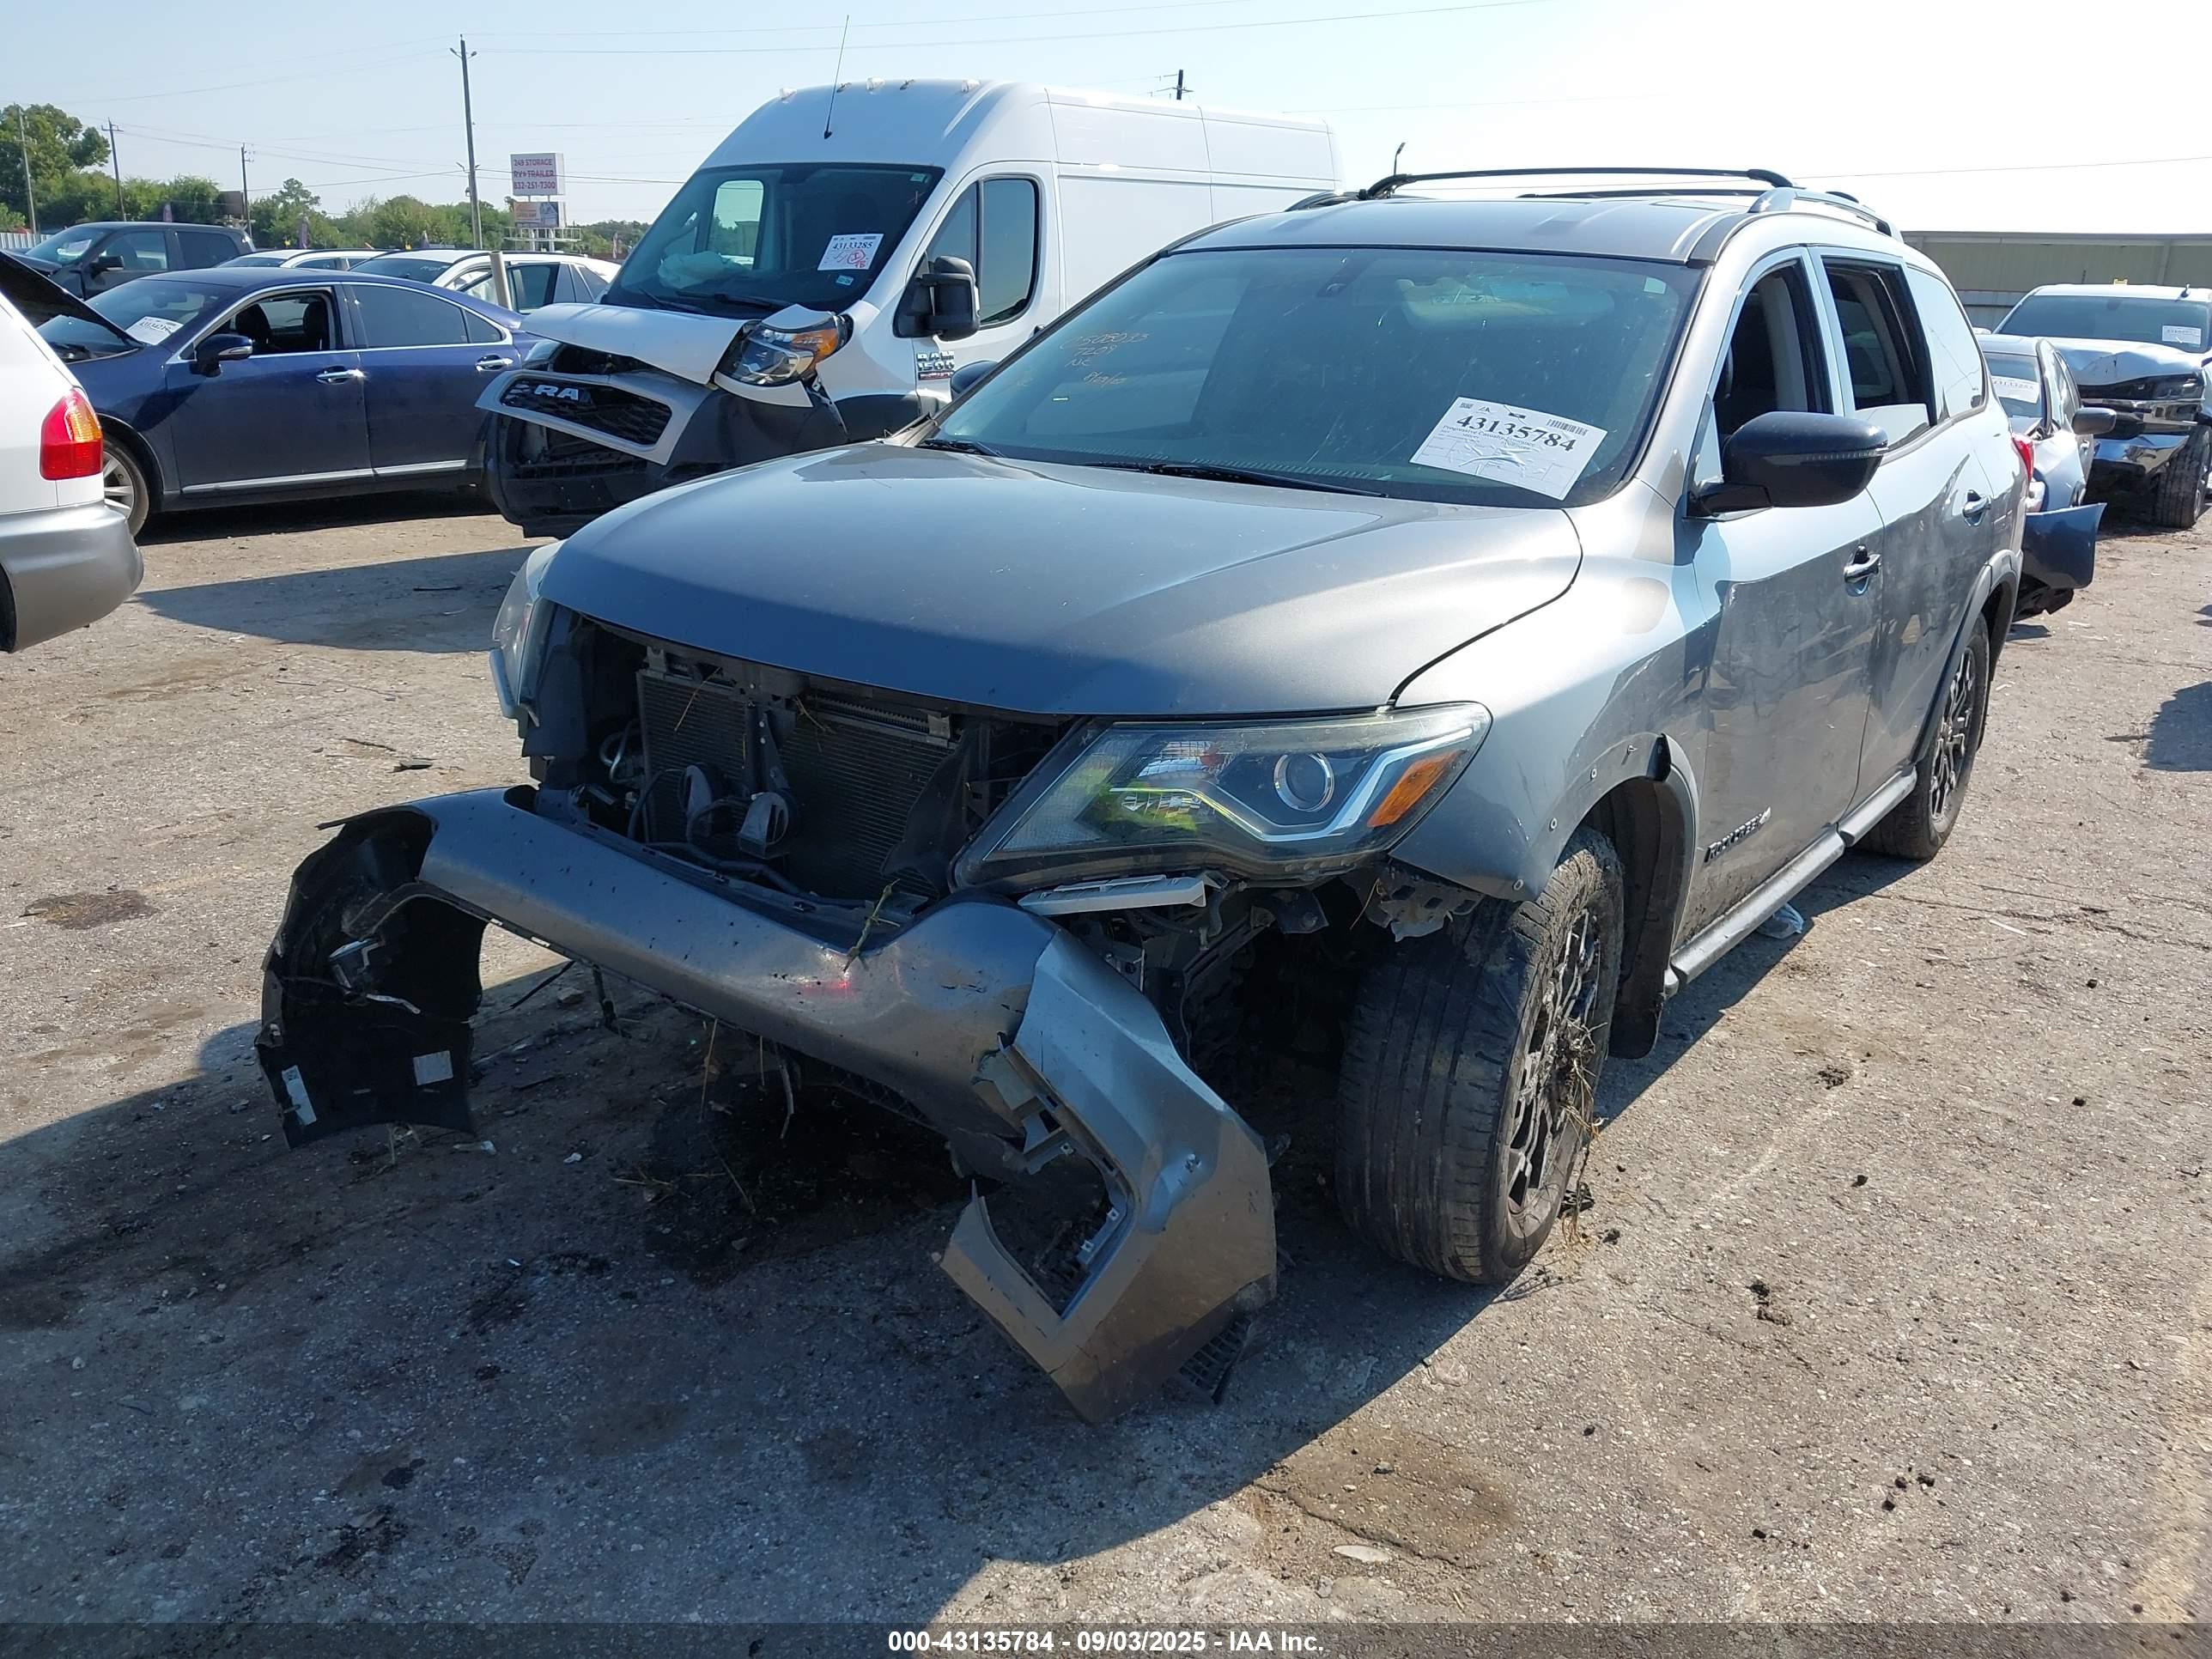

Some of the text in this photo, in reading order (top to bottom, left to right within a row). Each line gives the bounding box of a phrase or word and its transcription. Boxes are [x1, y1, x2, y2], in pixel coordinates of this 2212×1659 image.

[833, 241, 873, 250] 43133285
[916, 350, 955, 362] RAM
[916, 360, 956, 371] 1500
[1456, 415, 1577, 452] 43135784
